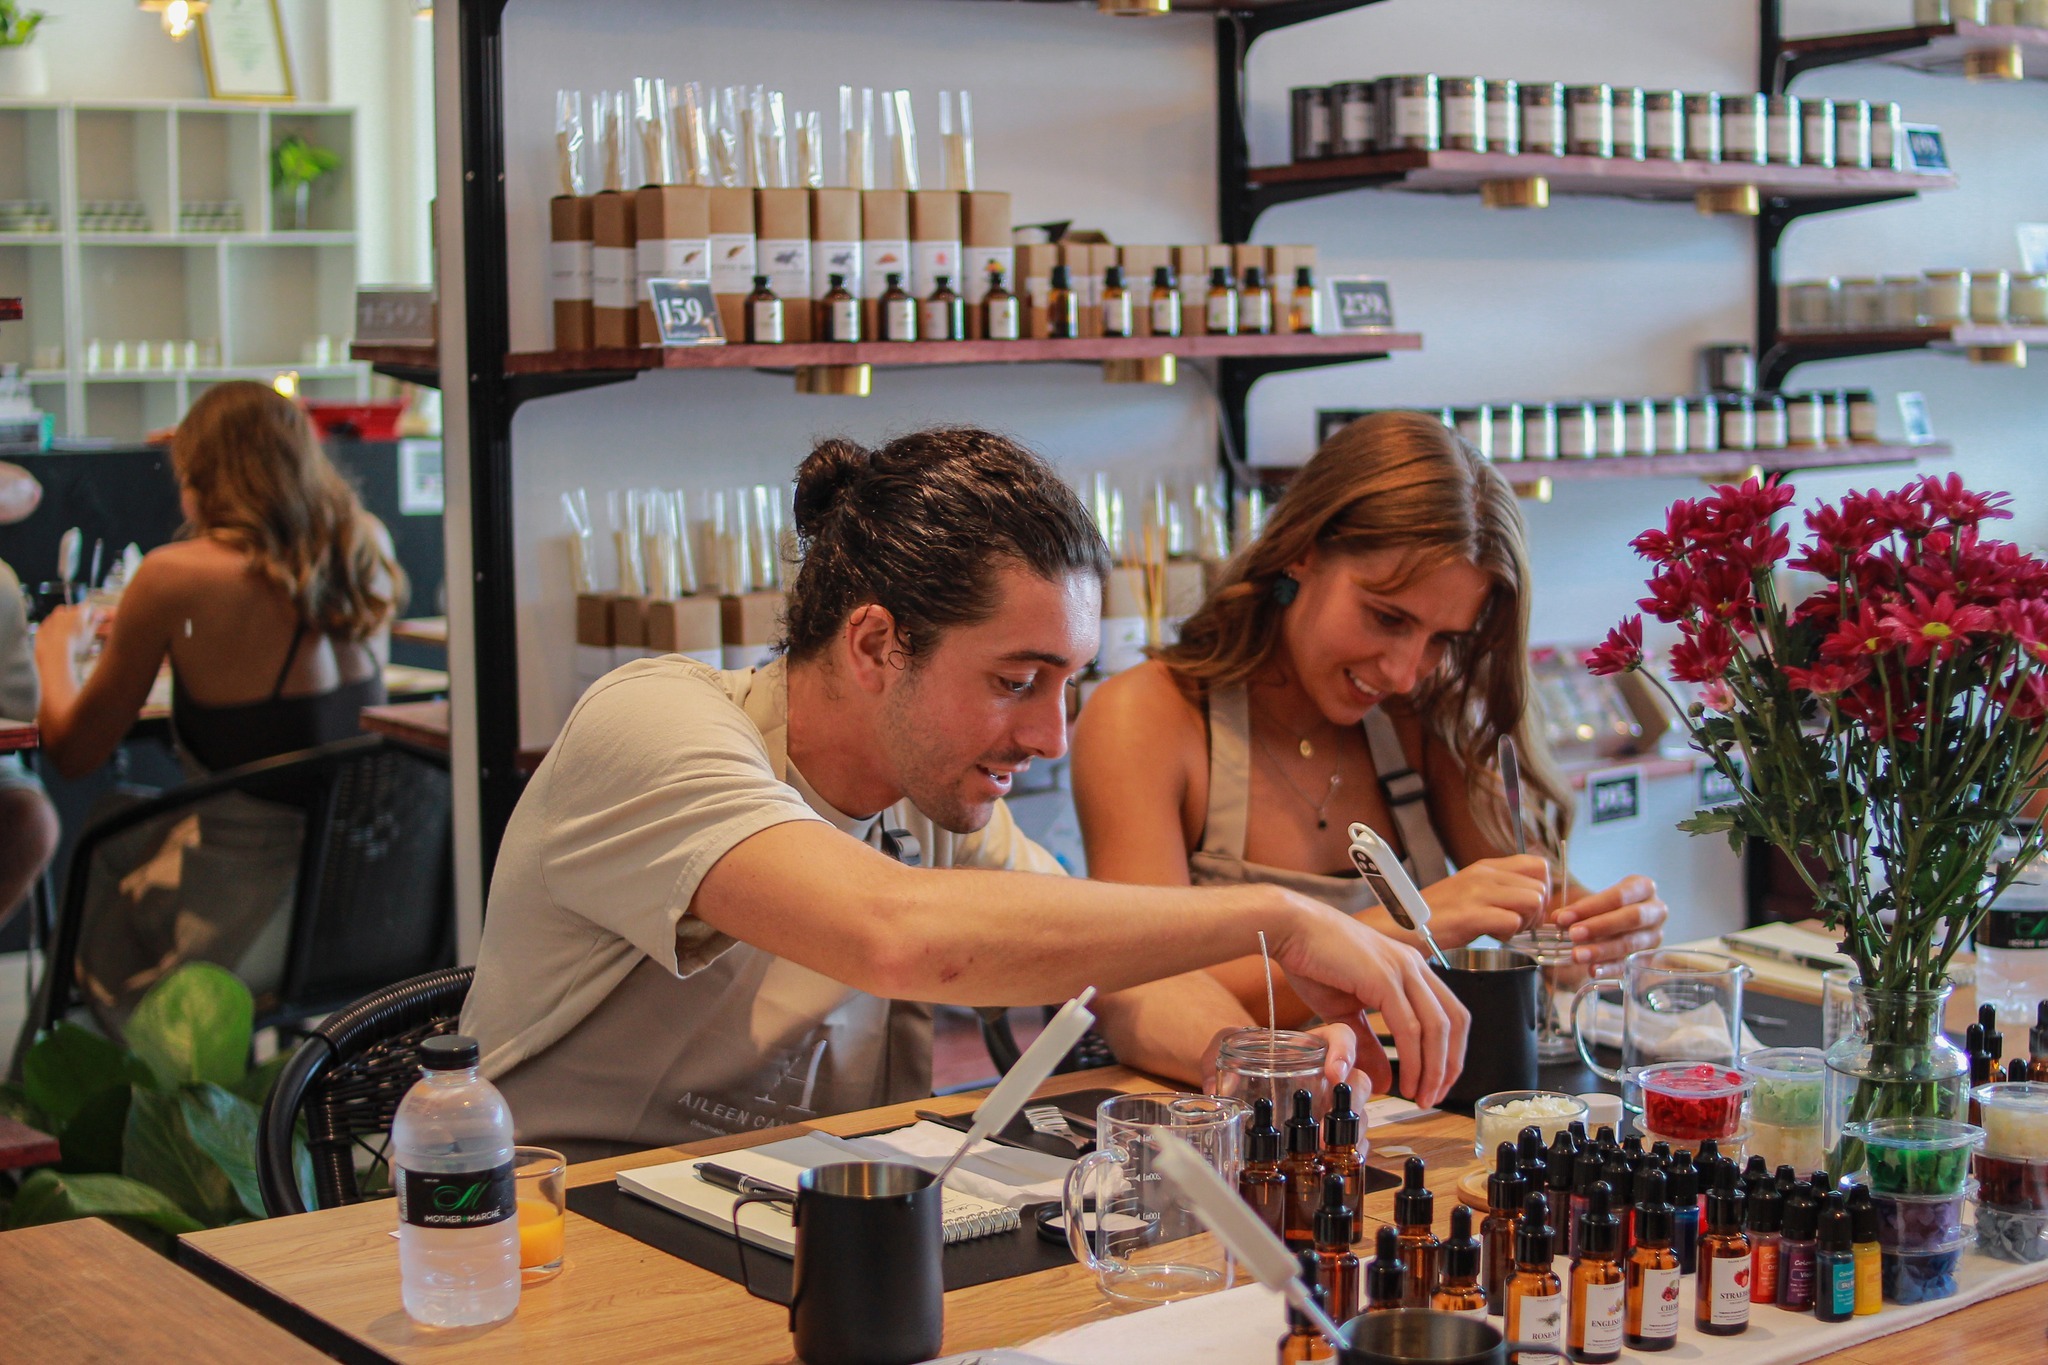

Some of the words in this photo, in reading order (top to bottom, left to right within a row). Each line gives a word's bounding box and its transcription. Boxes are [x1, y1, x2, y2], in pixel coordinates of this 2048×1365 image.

[677, 1091, 750, 1125] AILEEN
[424, 1215, 462, 1223] MOTHER
[468, 1205, 501, 1221] MARCHÉ
